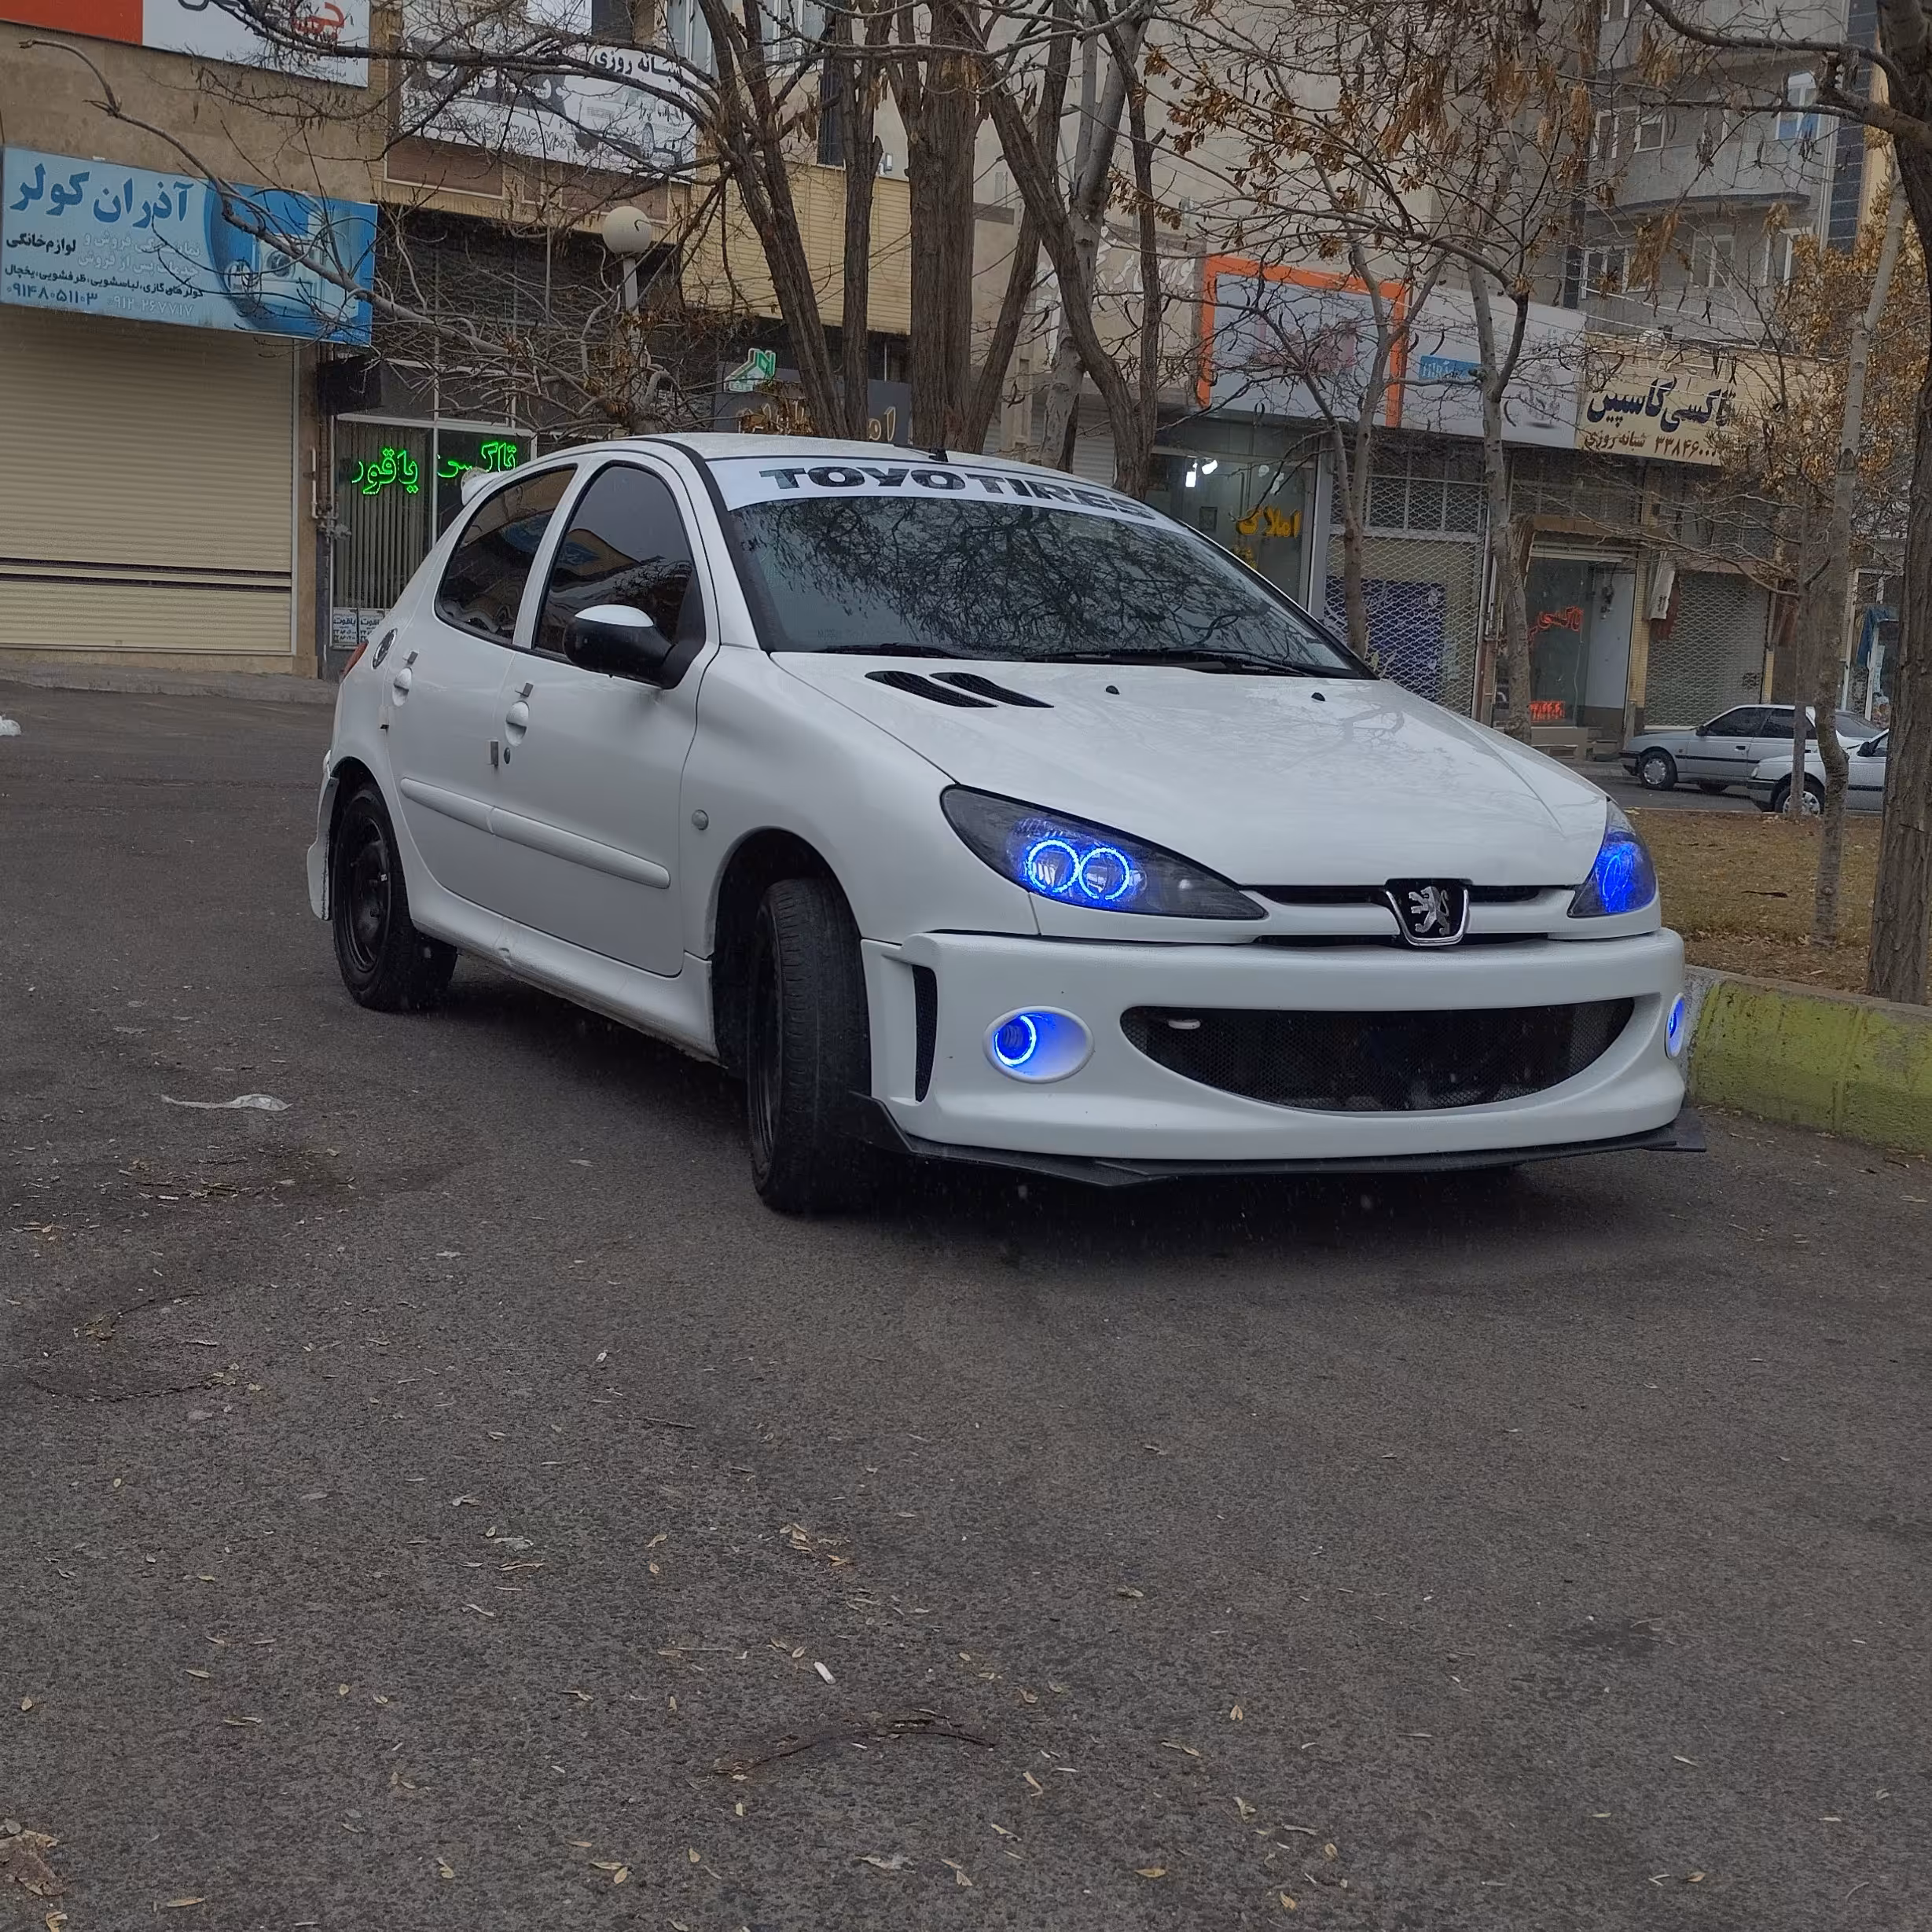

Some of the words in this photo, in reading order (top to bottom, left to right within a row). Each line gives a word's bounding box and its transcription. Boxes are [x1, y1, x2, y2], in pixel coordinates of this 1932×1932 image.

[595, 51, 632, 75] روزی
[9, 163, 90, 217] کولر
[93, 178, 194, 229] آذران
[6, 233, 46, 248] خانگی
[46, 237, 76, 255] لوازم
[83, 233, 92, 247] و
[94, 230, 132, 252] فروش
[78, 250, 116, 270] فروش
[119, 255, 131, 273] از
[132, 262, 154, 276] پس
[5, 264, 35, 278] یخچال
[1236, 505, 1302, 539] املاک
